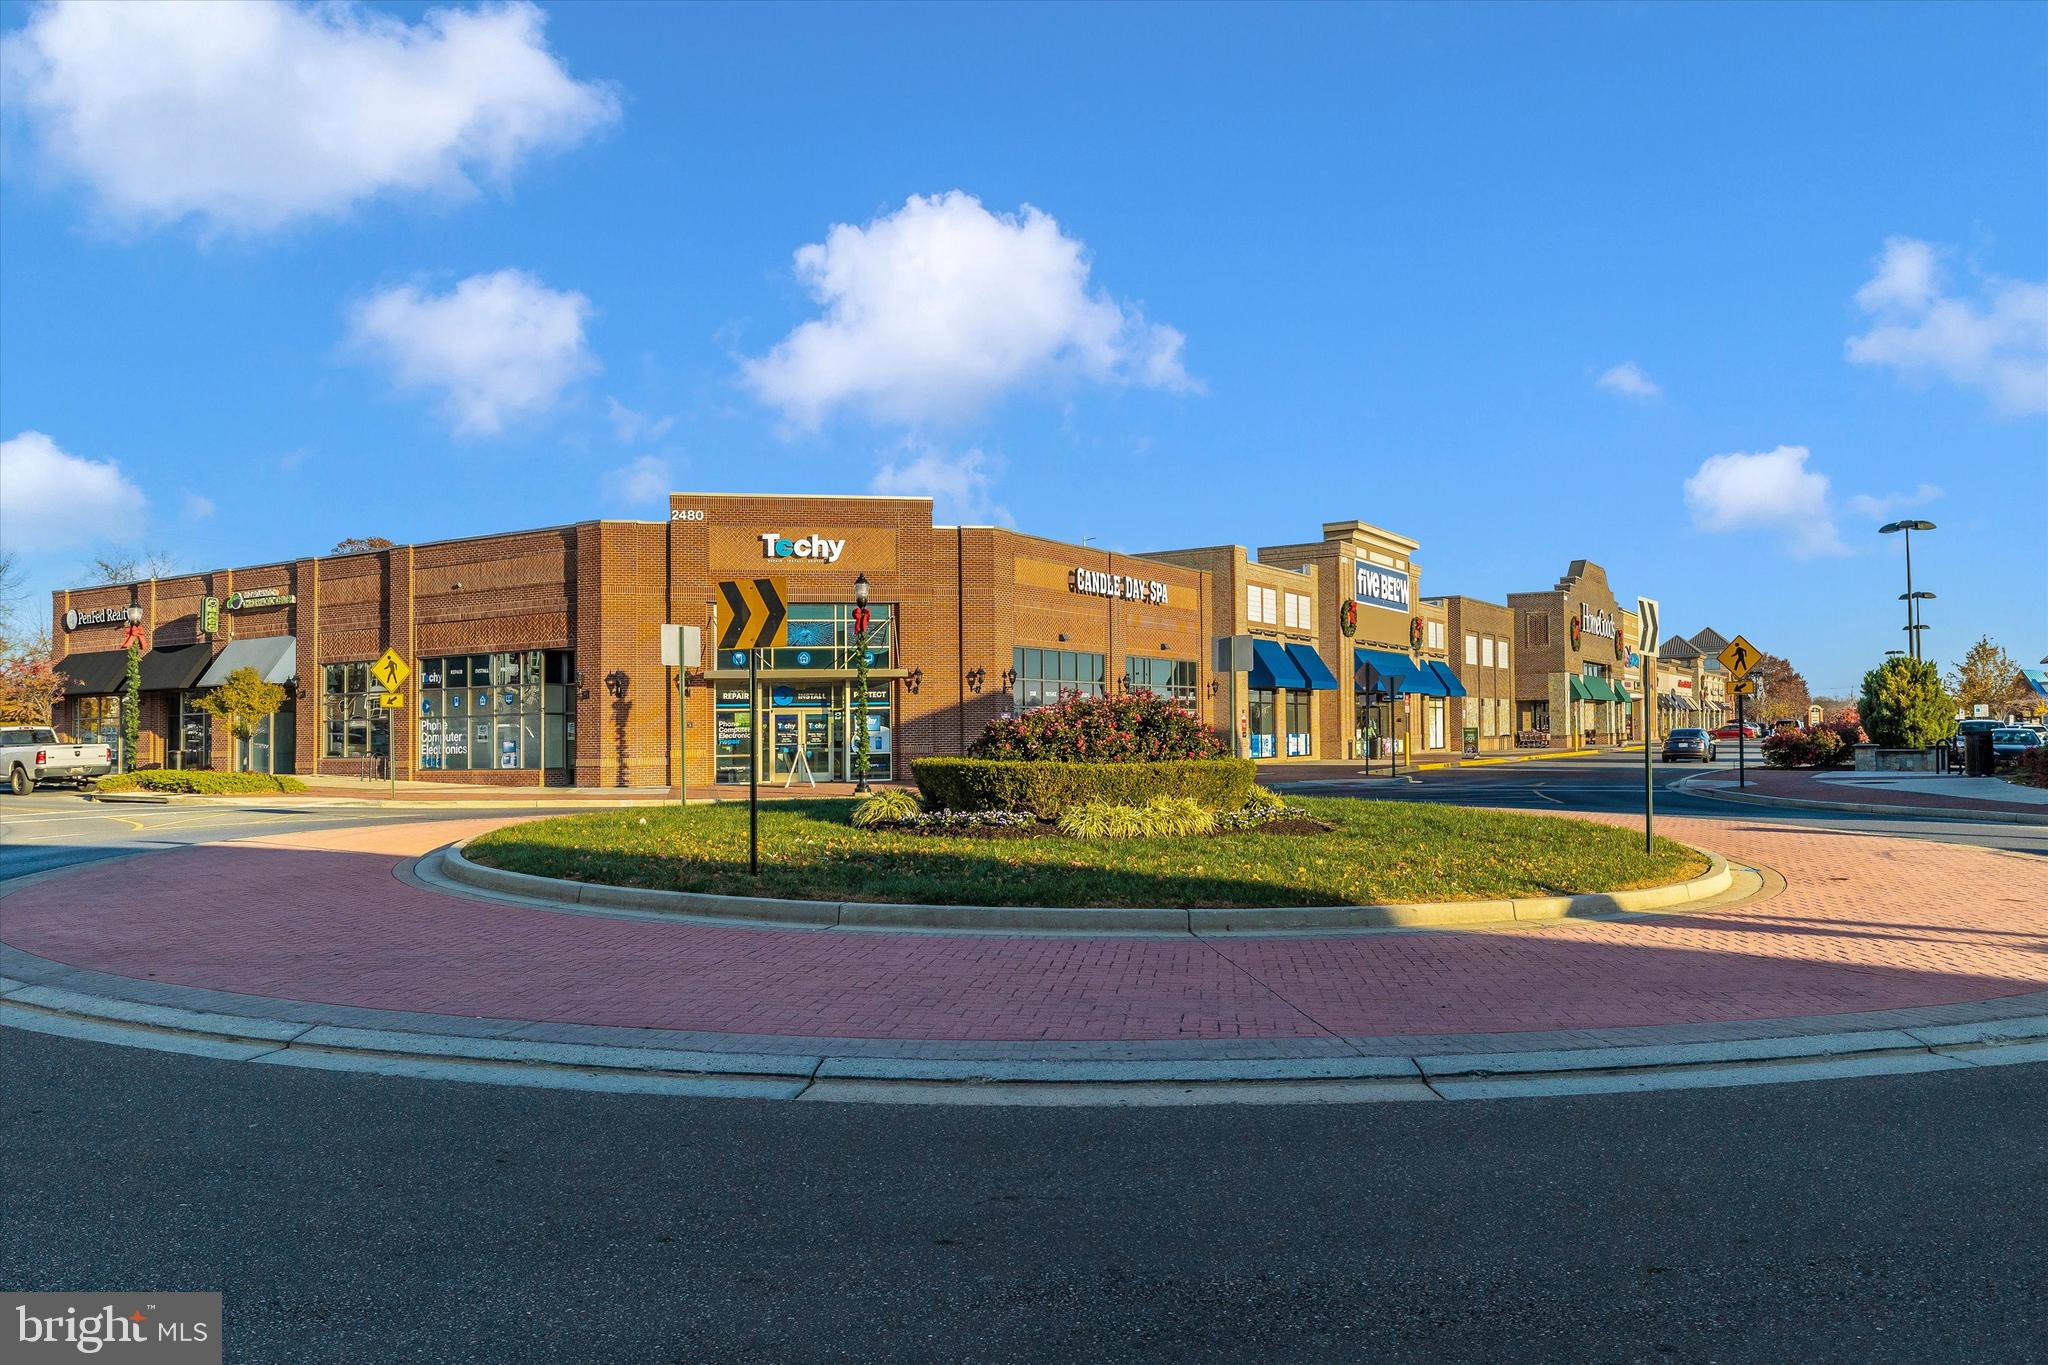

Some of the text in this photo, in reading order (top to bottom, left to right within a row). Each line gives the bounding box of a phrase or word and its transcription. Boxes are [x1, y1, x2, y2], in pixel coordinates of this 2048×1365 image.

[671, 510, 704, 521] 2480
[1077, 567, 1168, 604] CANDLE DAY SPA
[1358, 568, 1409, 605] five BELOW
[78, 606, 130, 625] PenFed Realt
[1582, 602, 1616, 640] HomeGoods
[723, 692, 750, 700] REPAIR
